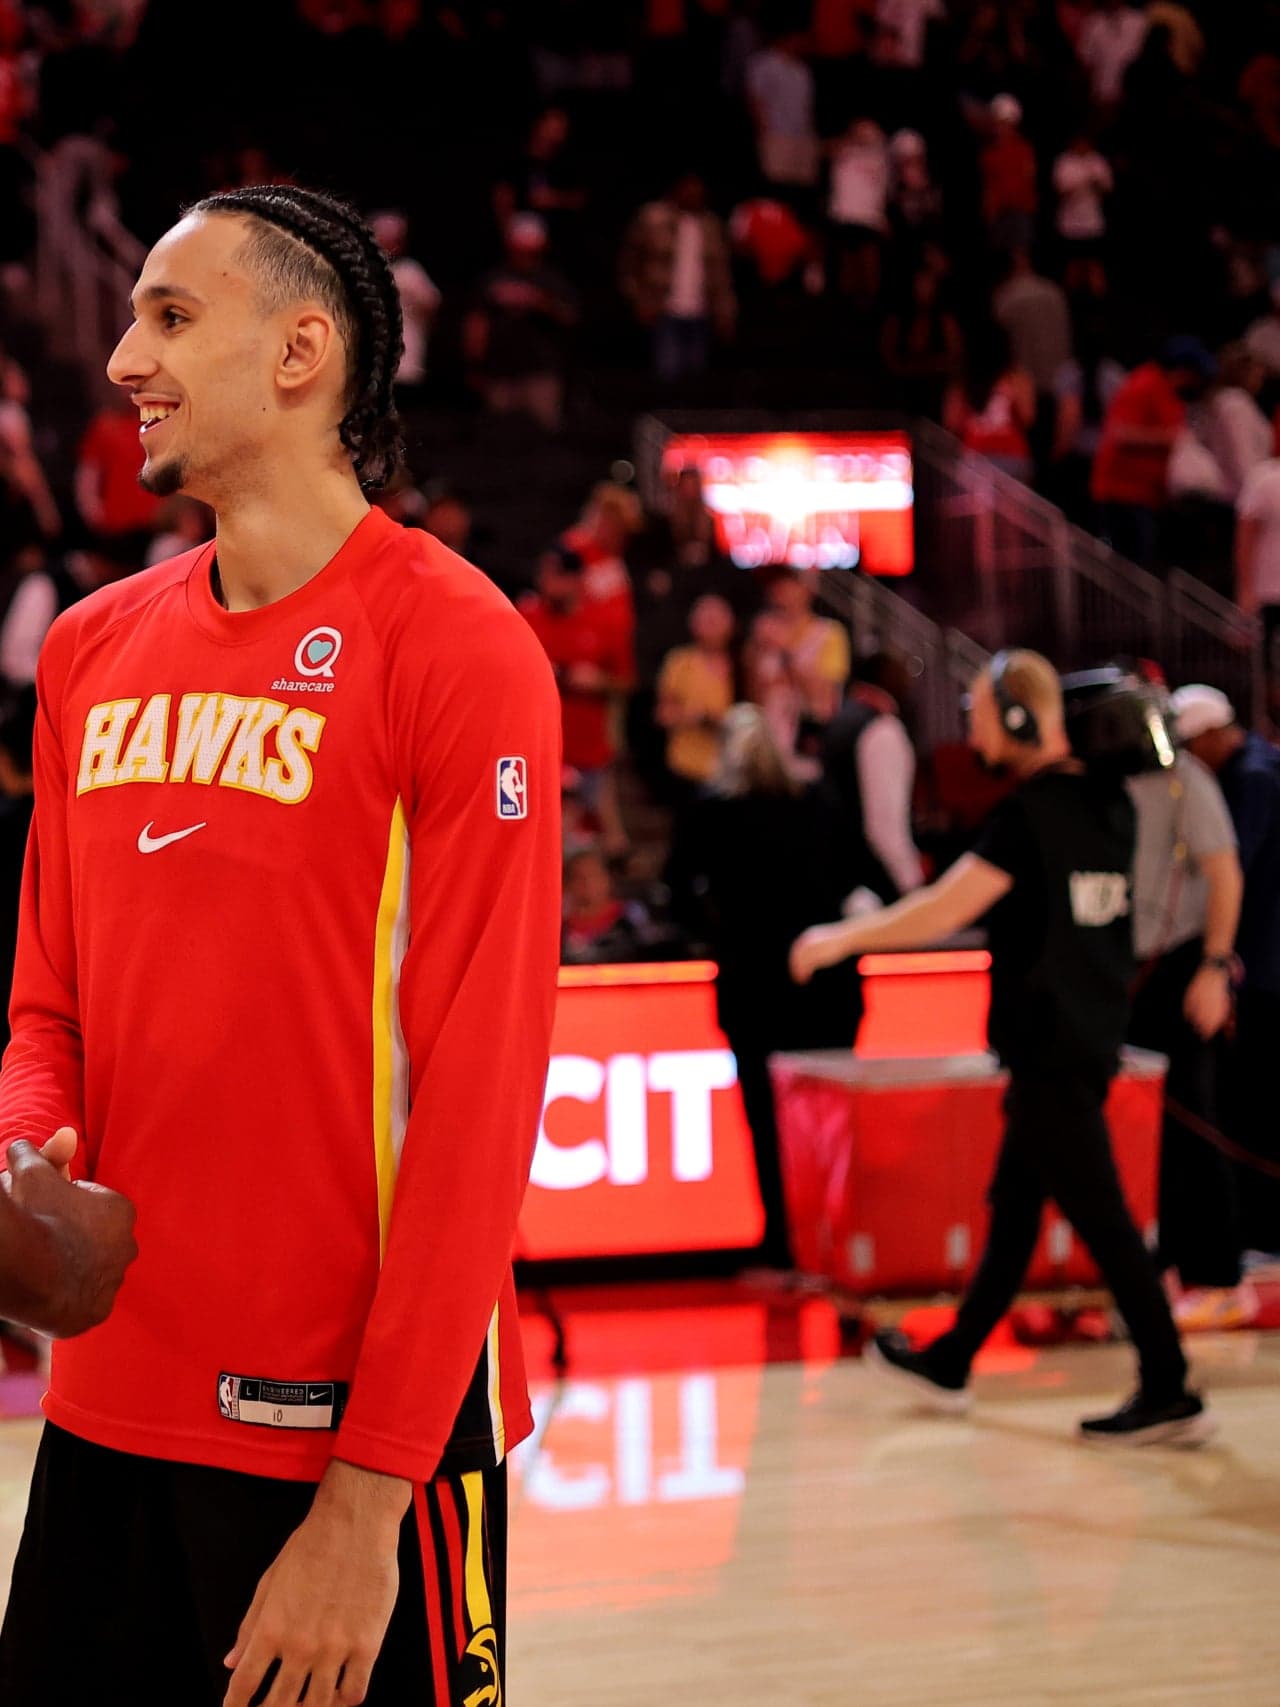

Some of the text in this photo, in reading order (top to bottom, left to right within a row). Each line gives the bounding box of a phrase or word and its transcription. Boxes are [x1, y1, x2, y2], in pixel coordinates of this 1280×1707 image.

[271, 678, 336, 693] sharecare
[76, 692, 327, 805] HAWKS
[529, 1049, 738, 1190] CIT
[246, 1385, 252, 1396] L
[273, 1408, 284, 1423] 10
